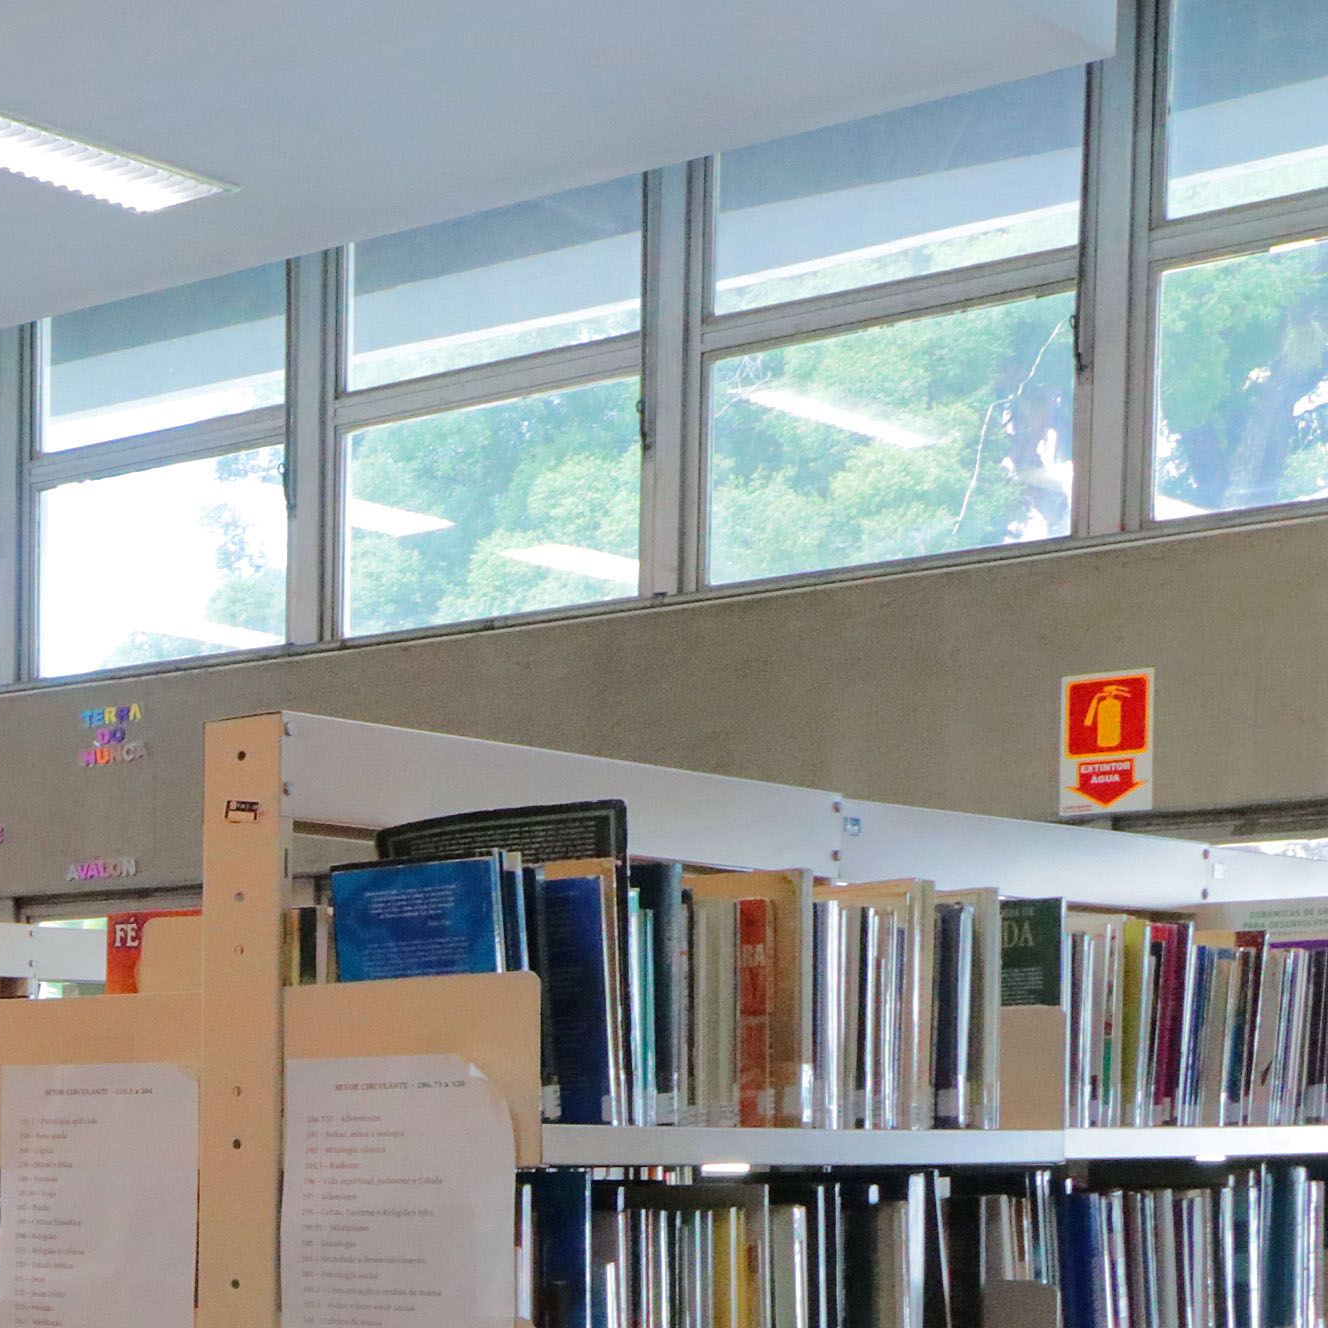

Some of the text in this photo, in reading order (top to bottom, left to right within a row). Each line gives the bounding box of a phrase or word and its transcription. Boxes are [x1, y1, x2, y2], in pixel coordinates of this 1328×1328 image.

[81, 703, 143, 727] TERRA
[96, 727, 126, 745] DO
[80, 743, 147, 767] NUNCA
[1080, 761, 1131, 774] EXTINTOR
[66, 859, 137, 881] AVALON
[115, 916, 140, 948] FÉ
